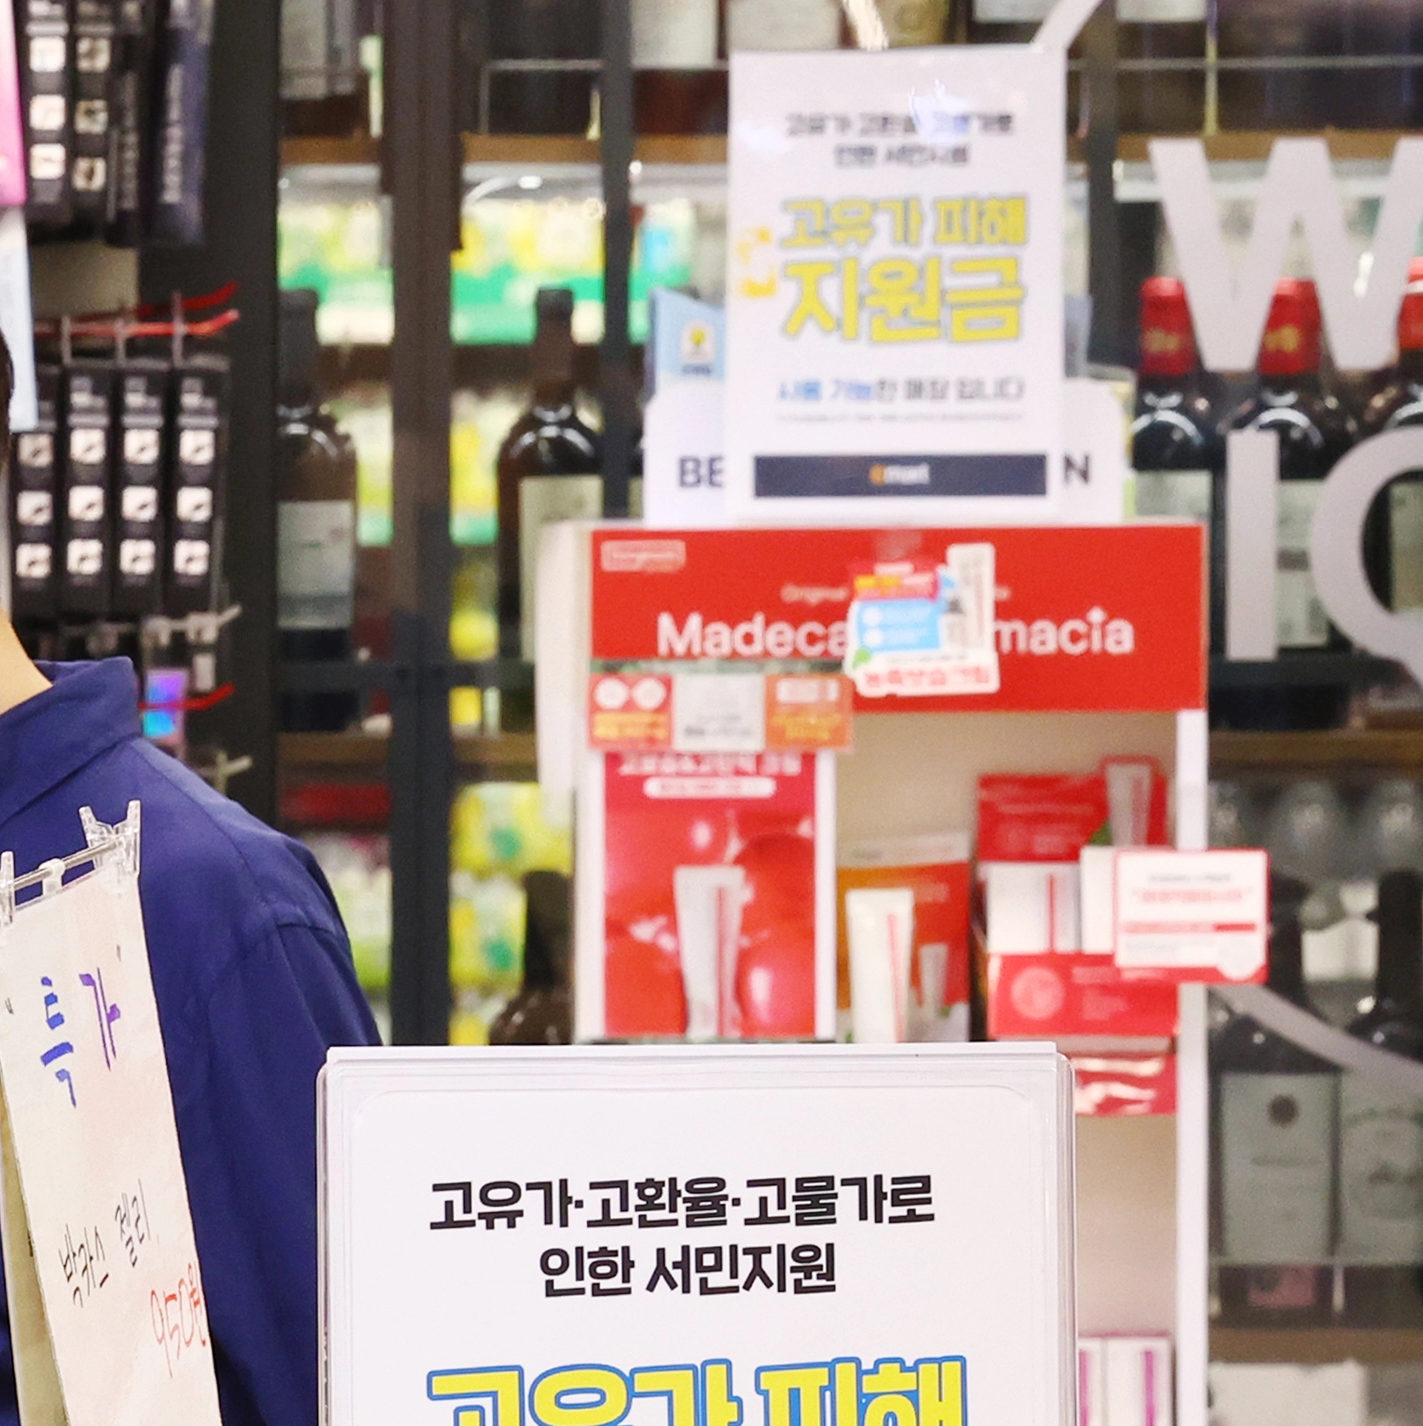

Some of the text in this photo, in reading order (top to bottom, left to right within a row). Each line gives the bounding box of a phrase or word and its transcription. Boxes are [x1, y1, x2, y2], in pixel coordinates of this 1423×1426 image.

[781, 192, 1029, 248] 고유가 피해
[781, 255, 1026, 344] 지원금
[429, 1174, 936, 1231] 고유가·고환율·고물가로
[538, 1242, 837, 1298] 인한 서민지원
